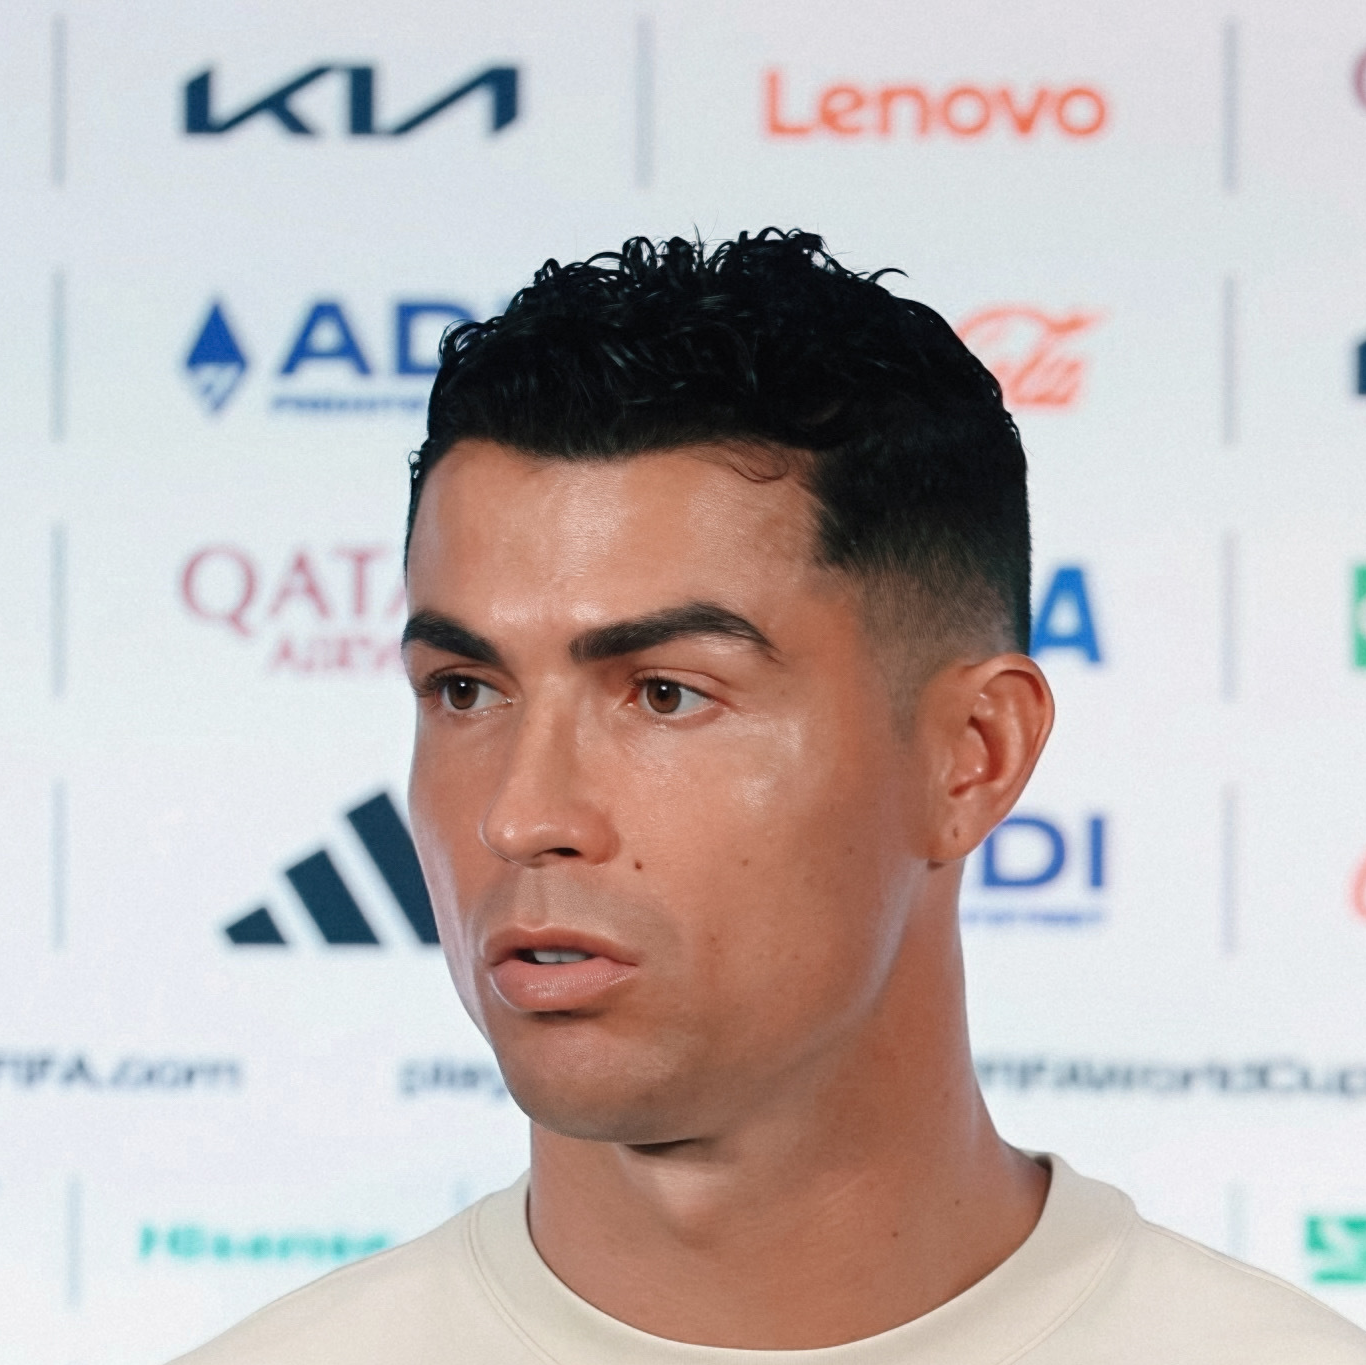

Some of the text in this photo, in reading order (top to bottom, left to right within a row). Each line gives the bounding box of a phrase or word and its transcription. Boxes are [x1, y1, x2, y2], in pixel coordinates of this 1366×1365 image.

[765, 71, 1109, 139] Lenovo
[280, 301, 478, 376] AD
[180, 546, 404, 637] QAT
[981, 816, 1106, 889] DI
